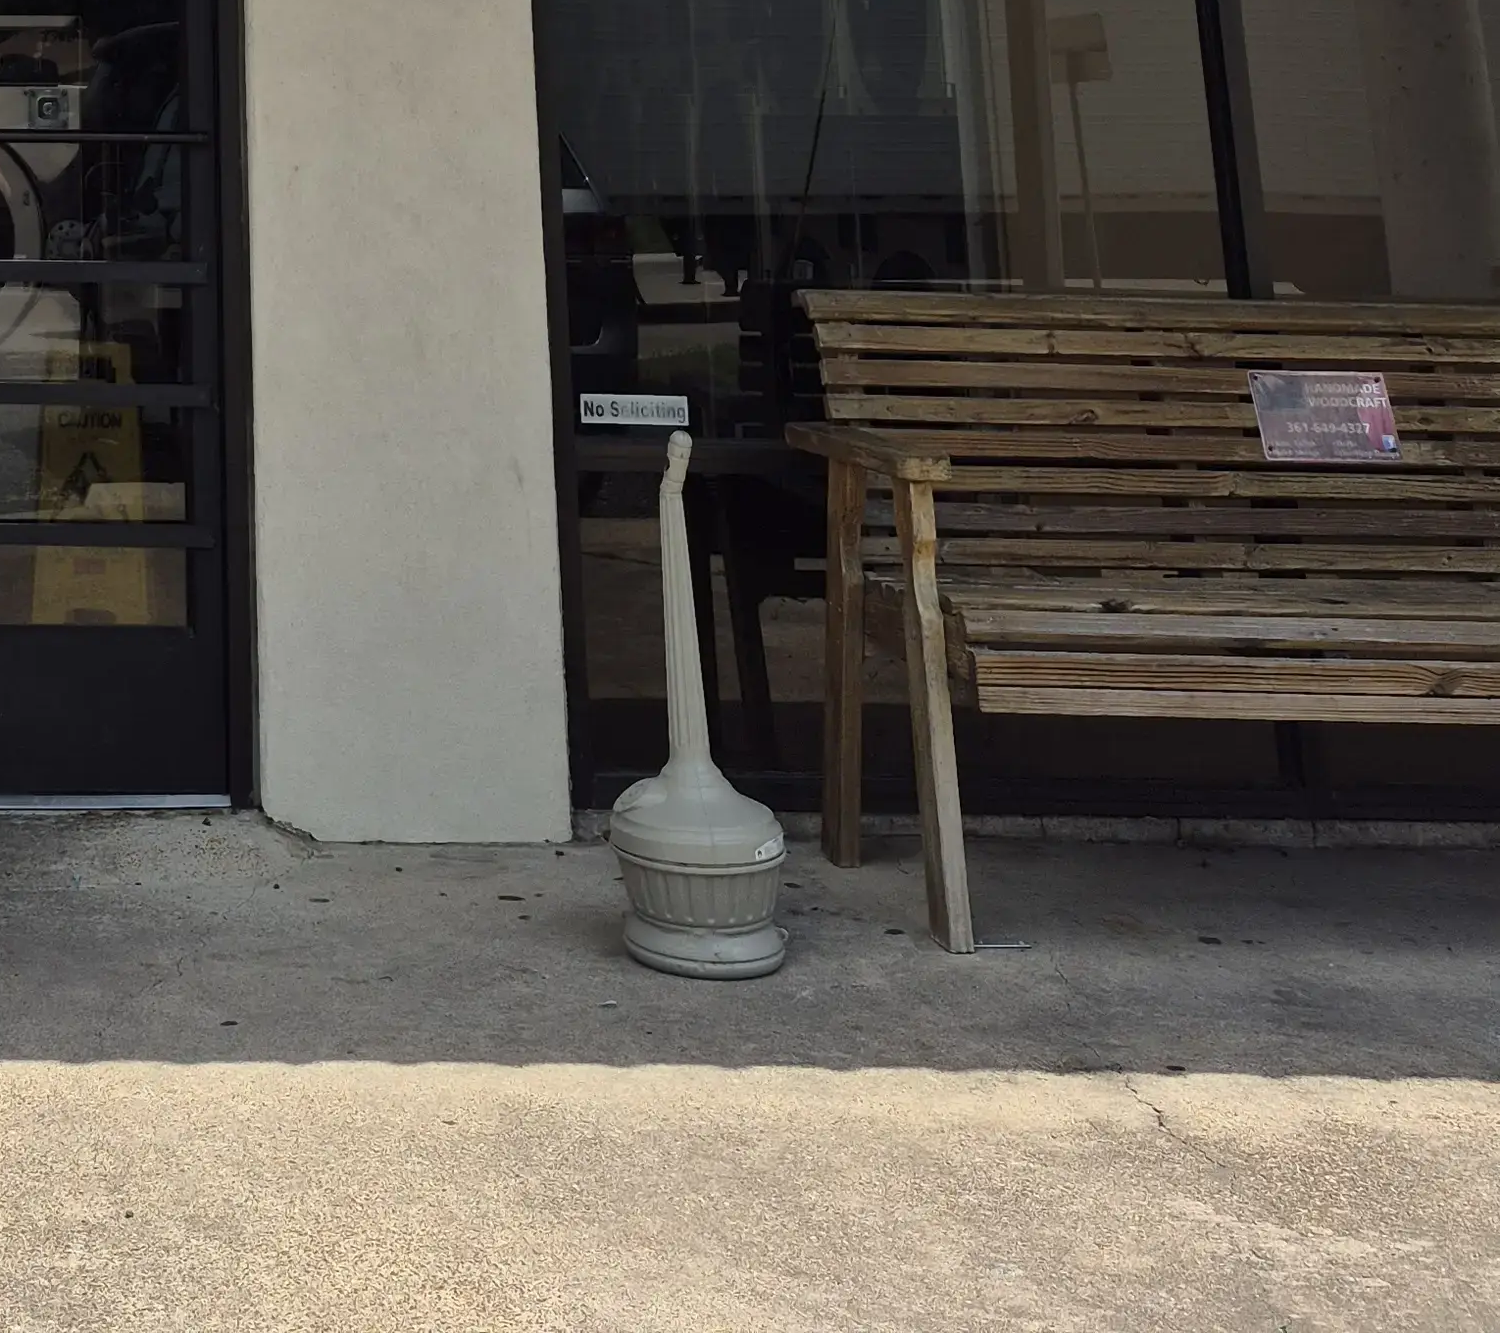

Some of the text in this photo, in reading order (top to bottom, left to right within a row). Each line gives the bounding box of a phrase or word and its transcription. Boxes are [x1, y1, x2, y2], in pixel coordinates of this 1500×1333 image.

[1304, 383, 1381, 395] HANDMADE
[1307, 396, 1388, 409] WOODCRAFT
[583, 400, 686, 424] No Soliciting
